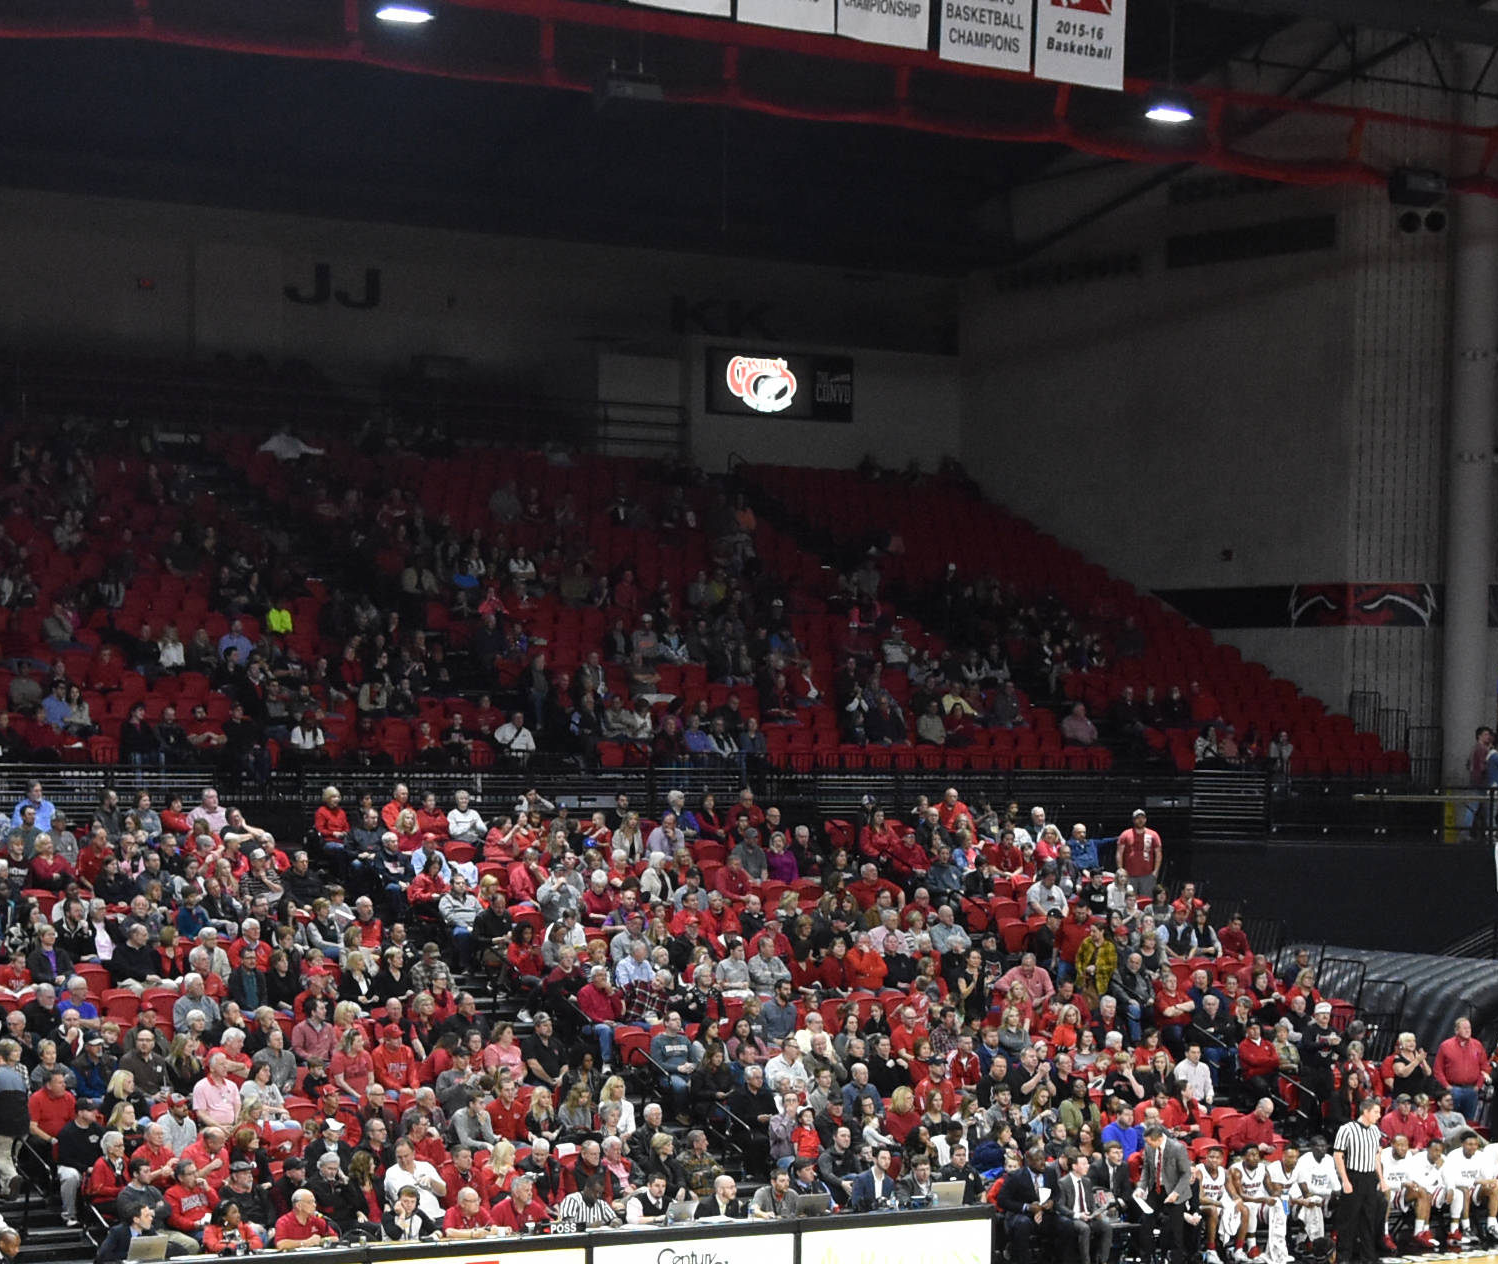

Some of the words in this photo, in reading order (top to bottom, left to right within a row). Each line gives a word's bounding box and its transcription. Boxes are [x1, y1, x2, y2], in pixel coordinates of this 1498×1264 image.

[946, 4, 1024, 30] BASKETBALL
[948, 28, 1020, 53] CHAMPIONS
[1056, 20, 1105, 41] 2015-16
[1046, 37, 1113, 60] Basketball
[550, 1222, 577, 1234] POSS
